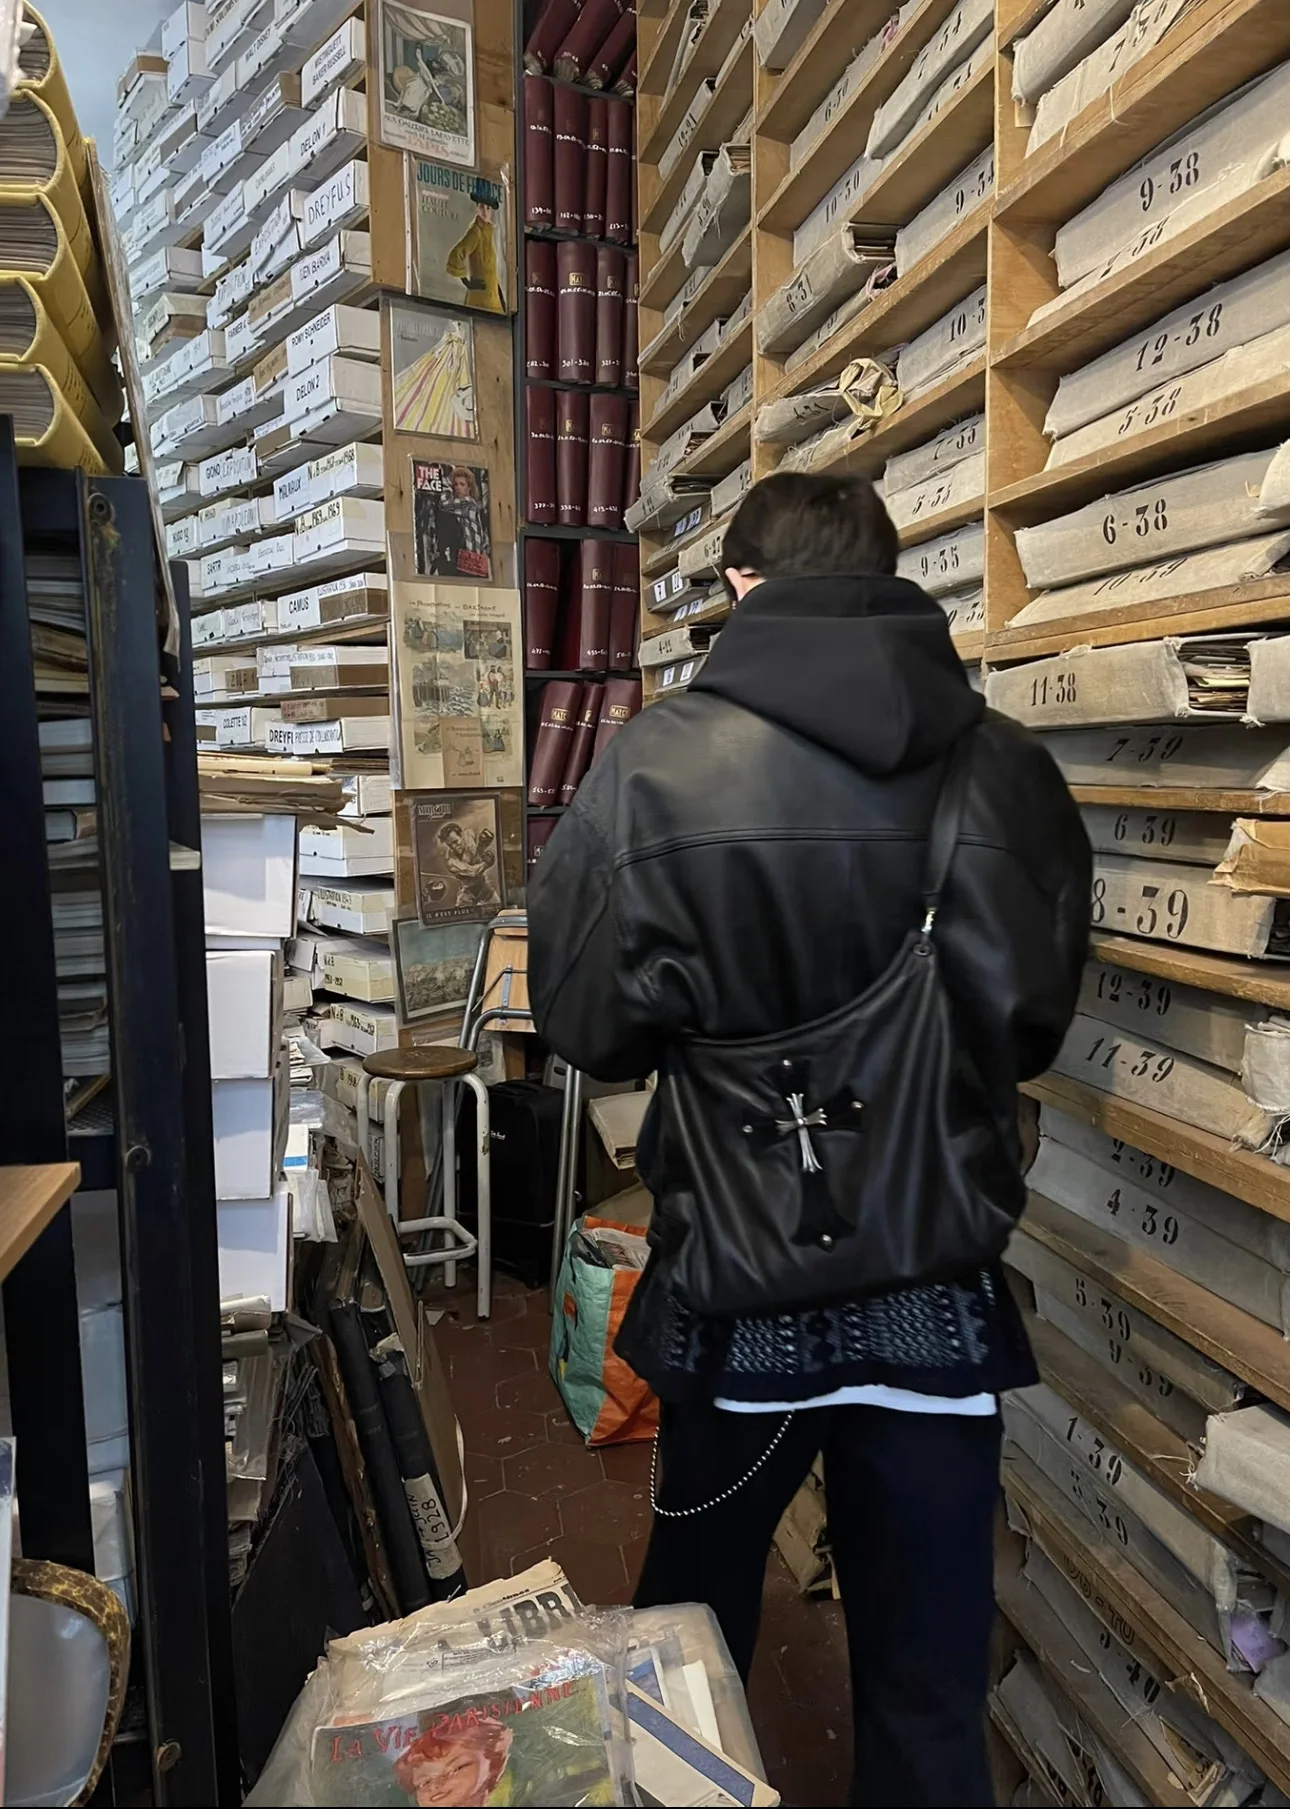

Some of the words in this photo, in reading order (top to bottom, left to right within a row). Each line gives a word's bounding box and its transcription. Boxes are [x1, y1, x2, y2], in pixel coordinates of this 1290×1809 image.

[300, 130, 322, 157] DELON
[308, 172, 352, 226] DREYFUS
[416, 162, 450, 189] JOURS
[452, 171, 465, 192] DE
[1139, 151, 1201, 213] 9-38
[304, 311, 332, 340] SCHNEIDER
[950, 296, 985, 341] 10-3
[1135, 302, 1223, 372] 12-38
[296, 381, 316, 402] DELON
[416, 477, 442, 492] FACE
[419, 465, 440, 480] THE
[1102, 498, 1169, 545] 6-38
[920, 545, 960, 578] 9-35
[1105, 735, 1184, 763] 7-39
[1091, 878, 1189, 939] 8-39
[1096, 971, 1172, 1017] 12-39
[1085, 1037, 1175, 1083] 11-39
[1065, 1416, 1123, 1487] 1-39
[421, 1498, 450, 1543] 1928
[373, 1725, 418, 1752] VIE
[430, 1683, 576, 1737] PARISIENNE
